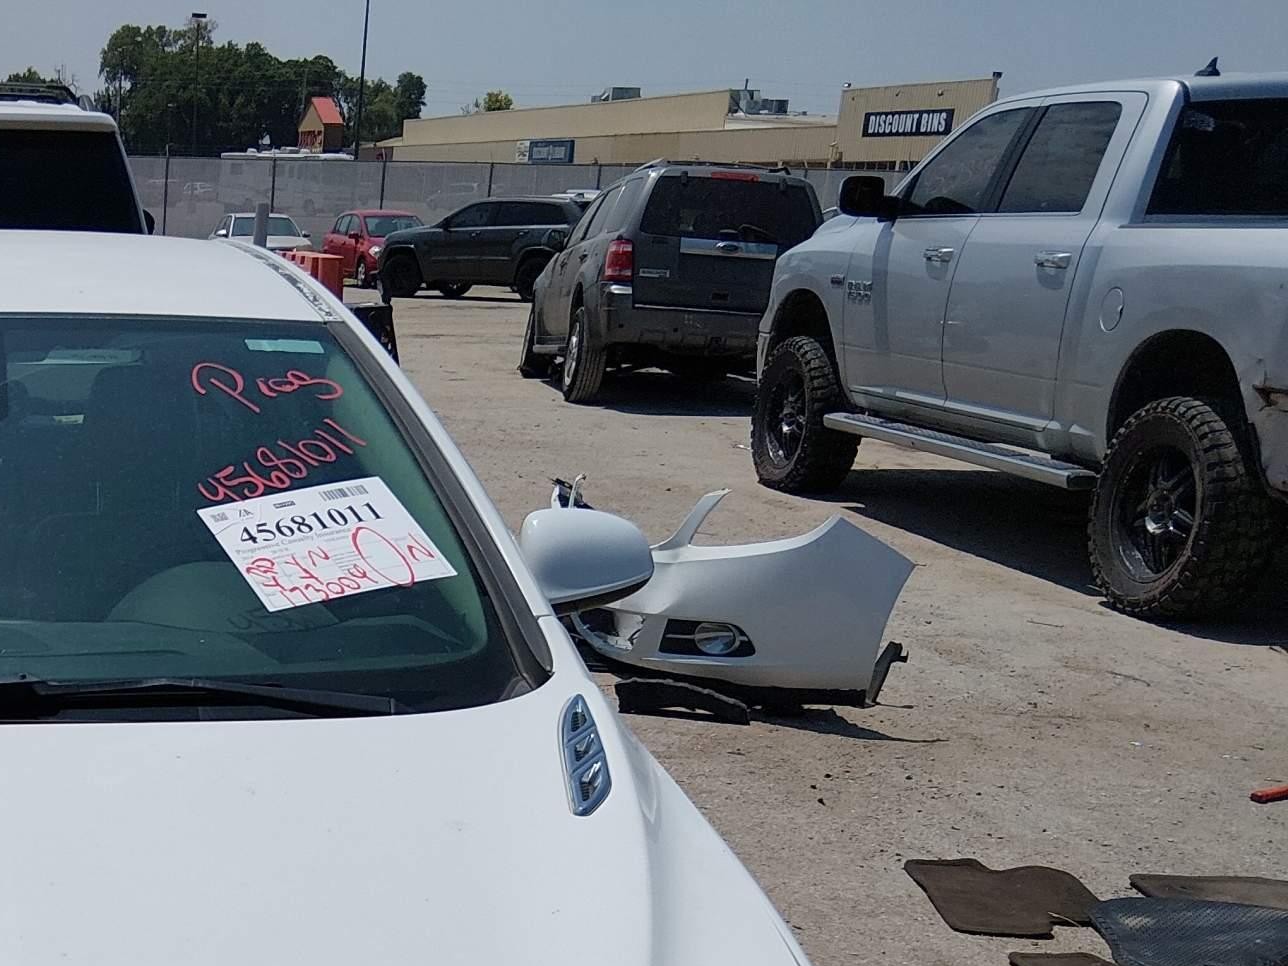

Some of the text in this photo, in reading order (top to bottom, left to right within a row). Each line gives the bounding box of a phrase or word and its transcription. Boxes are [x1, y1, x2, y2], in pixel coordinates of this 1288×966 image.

[868, 112, 947, 133] DISCOUNT BINS
[198, 418, 367, 503] 45681011
[240, 502, 384, 545] 45681011
